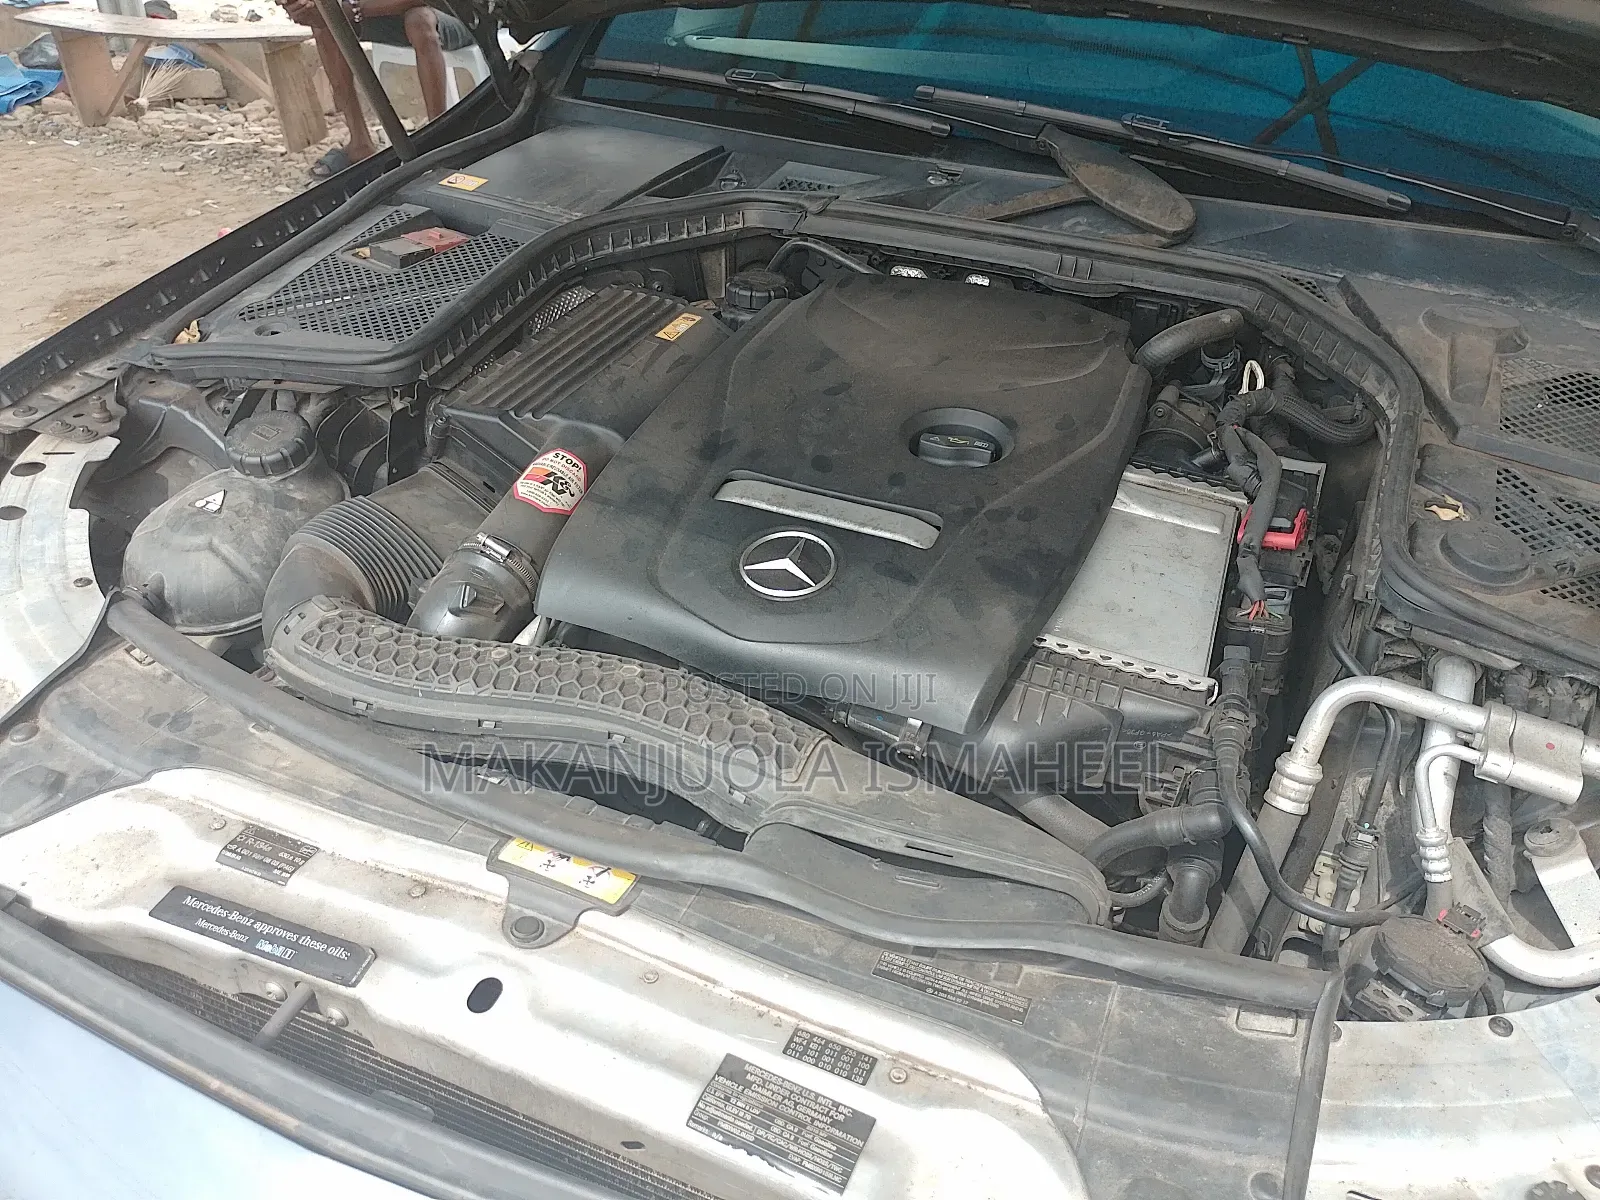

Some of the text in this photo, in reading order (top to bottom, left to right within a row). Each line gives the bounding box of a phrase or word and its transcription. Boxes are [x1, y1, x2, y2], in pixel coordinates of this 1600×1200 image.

[553, 452, 582, 473] STOP!
[561, 463, 582, 482] DISCARD
[245, 837, 272, 851] R-134a
[183, 896, 350, 960] Mercedes-Benz approves these oils:
[195, 918, 248, 942] Mercedes-Benz
[255, 939, 285, 956] Mobil
[786, 1048, 863, 1083] 011 000 010 010 138
[790, 1042, 866, 1077] 010 101 001 010 011
[812, 1036, 825, 1045] 464
[828, 1042, 841, 1051] 650
[844, 1048, 856, 1057] 755
[861, 1054, 873, 1063] 141
[824, 1048, 838, 1057] 011
[840, 1054, 853, 1063] 001
[857, 1061, 870, 1070] 100
[744, 1063, 802, 1093] MERCEDES-BENZ
[801, 1089, 815, 1100] U.S.
[837, 1105, 852, 1117] INC.
[745, 1073, 845, 1122] MFD. UNDER CONTRACT FOR
[751, 1083, 782, 1102] DAIMLER
[796, 1104, 832, 1124] GERMANY
[714, 1074, 864, 1147] VEHICLE EMISSION CONTROL INFORMATION
